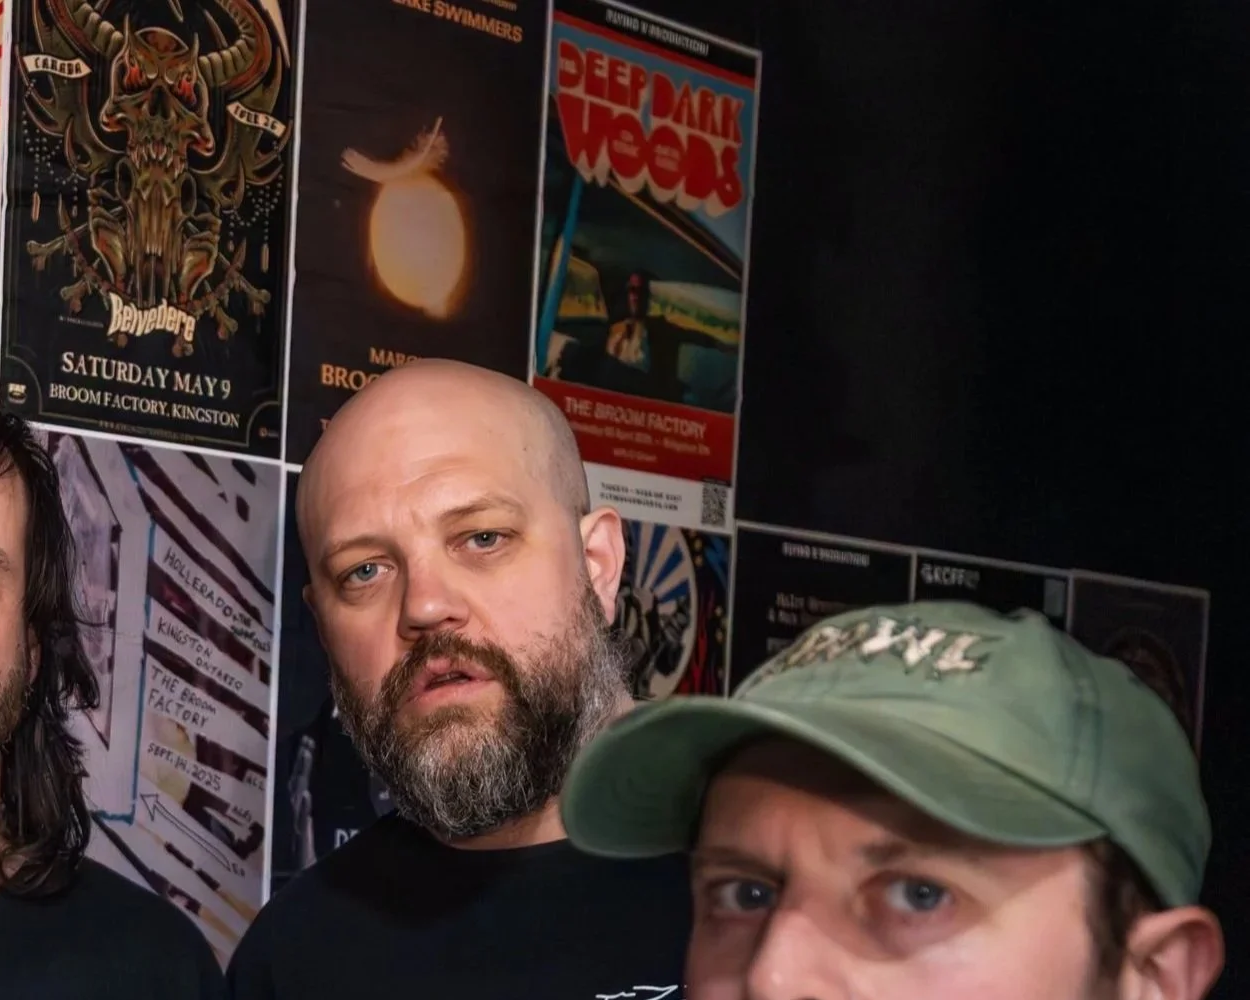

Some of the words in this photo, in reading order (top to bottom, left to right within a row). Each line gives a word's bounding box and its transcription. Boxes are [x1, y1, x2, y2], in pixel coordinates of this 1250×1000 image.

[433, 0, 524, 43] SWIMMERS
[34, 57, 82, 75] CANADA
[558, 38, 648, 111] DEEP
[650, 71, 744, 145] DARK
[557, 92, 744, 212] WOODS
[107, 291, 196, 342] Belvedere
[62, 352, 170, 389] SATURDAY
[174, 371, 218, 397] MAY
[220, 379, 231, 400] 9
[50, 384, 100, 406] BROOM
[173, 402, 240, 428] KINGSTON
[564, 396, 591, 417] THE
[594, 402, 646, 428] BROOM
[647, 411, 707, 440] FACTORY
[163, 548, 233, 618] HOLLERADO
[158, 617, 213, 658] KINGSTON
[151, 665, 179, 693] THE
[181, 687, 216, 716] BROOM
[196, 657, 243, 690] ONTARIO
[149, 688, 208, 729] FACTORY
